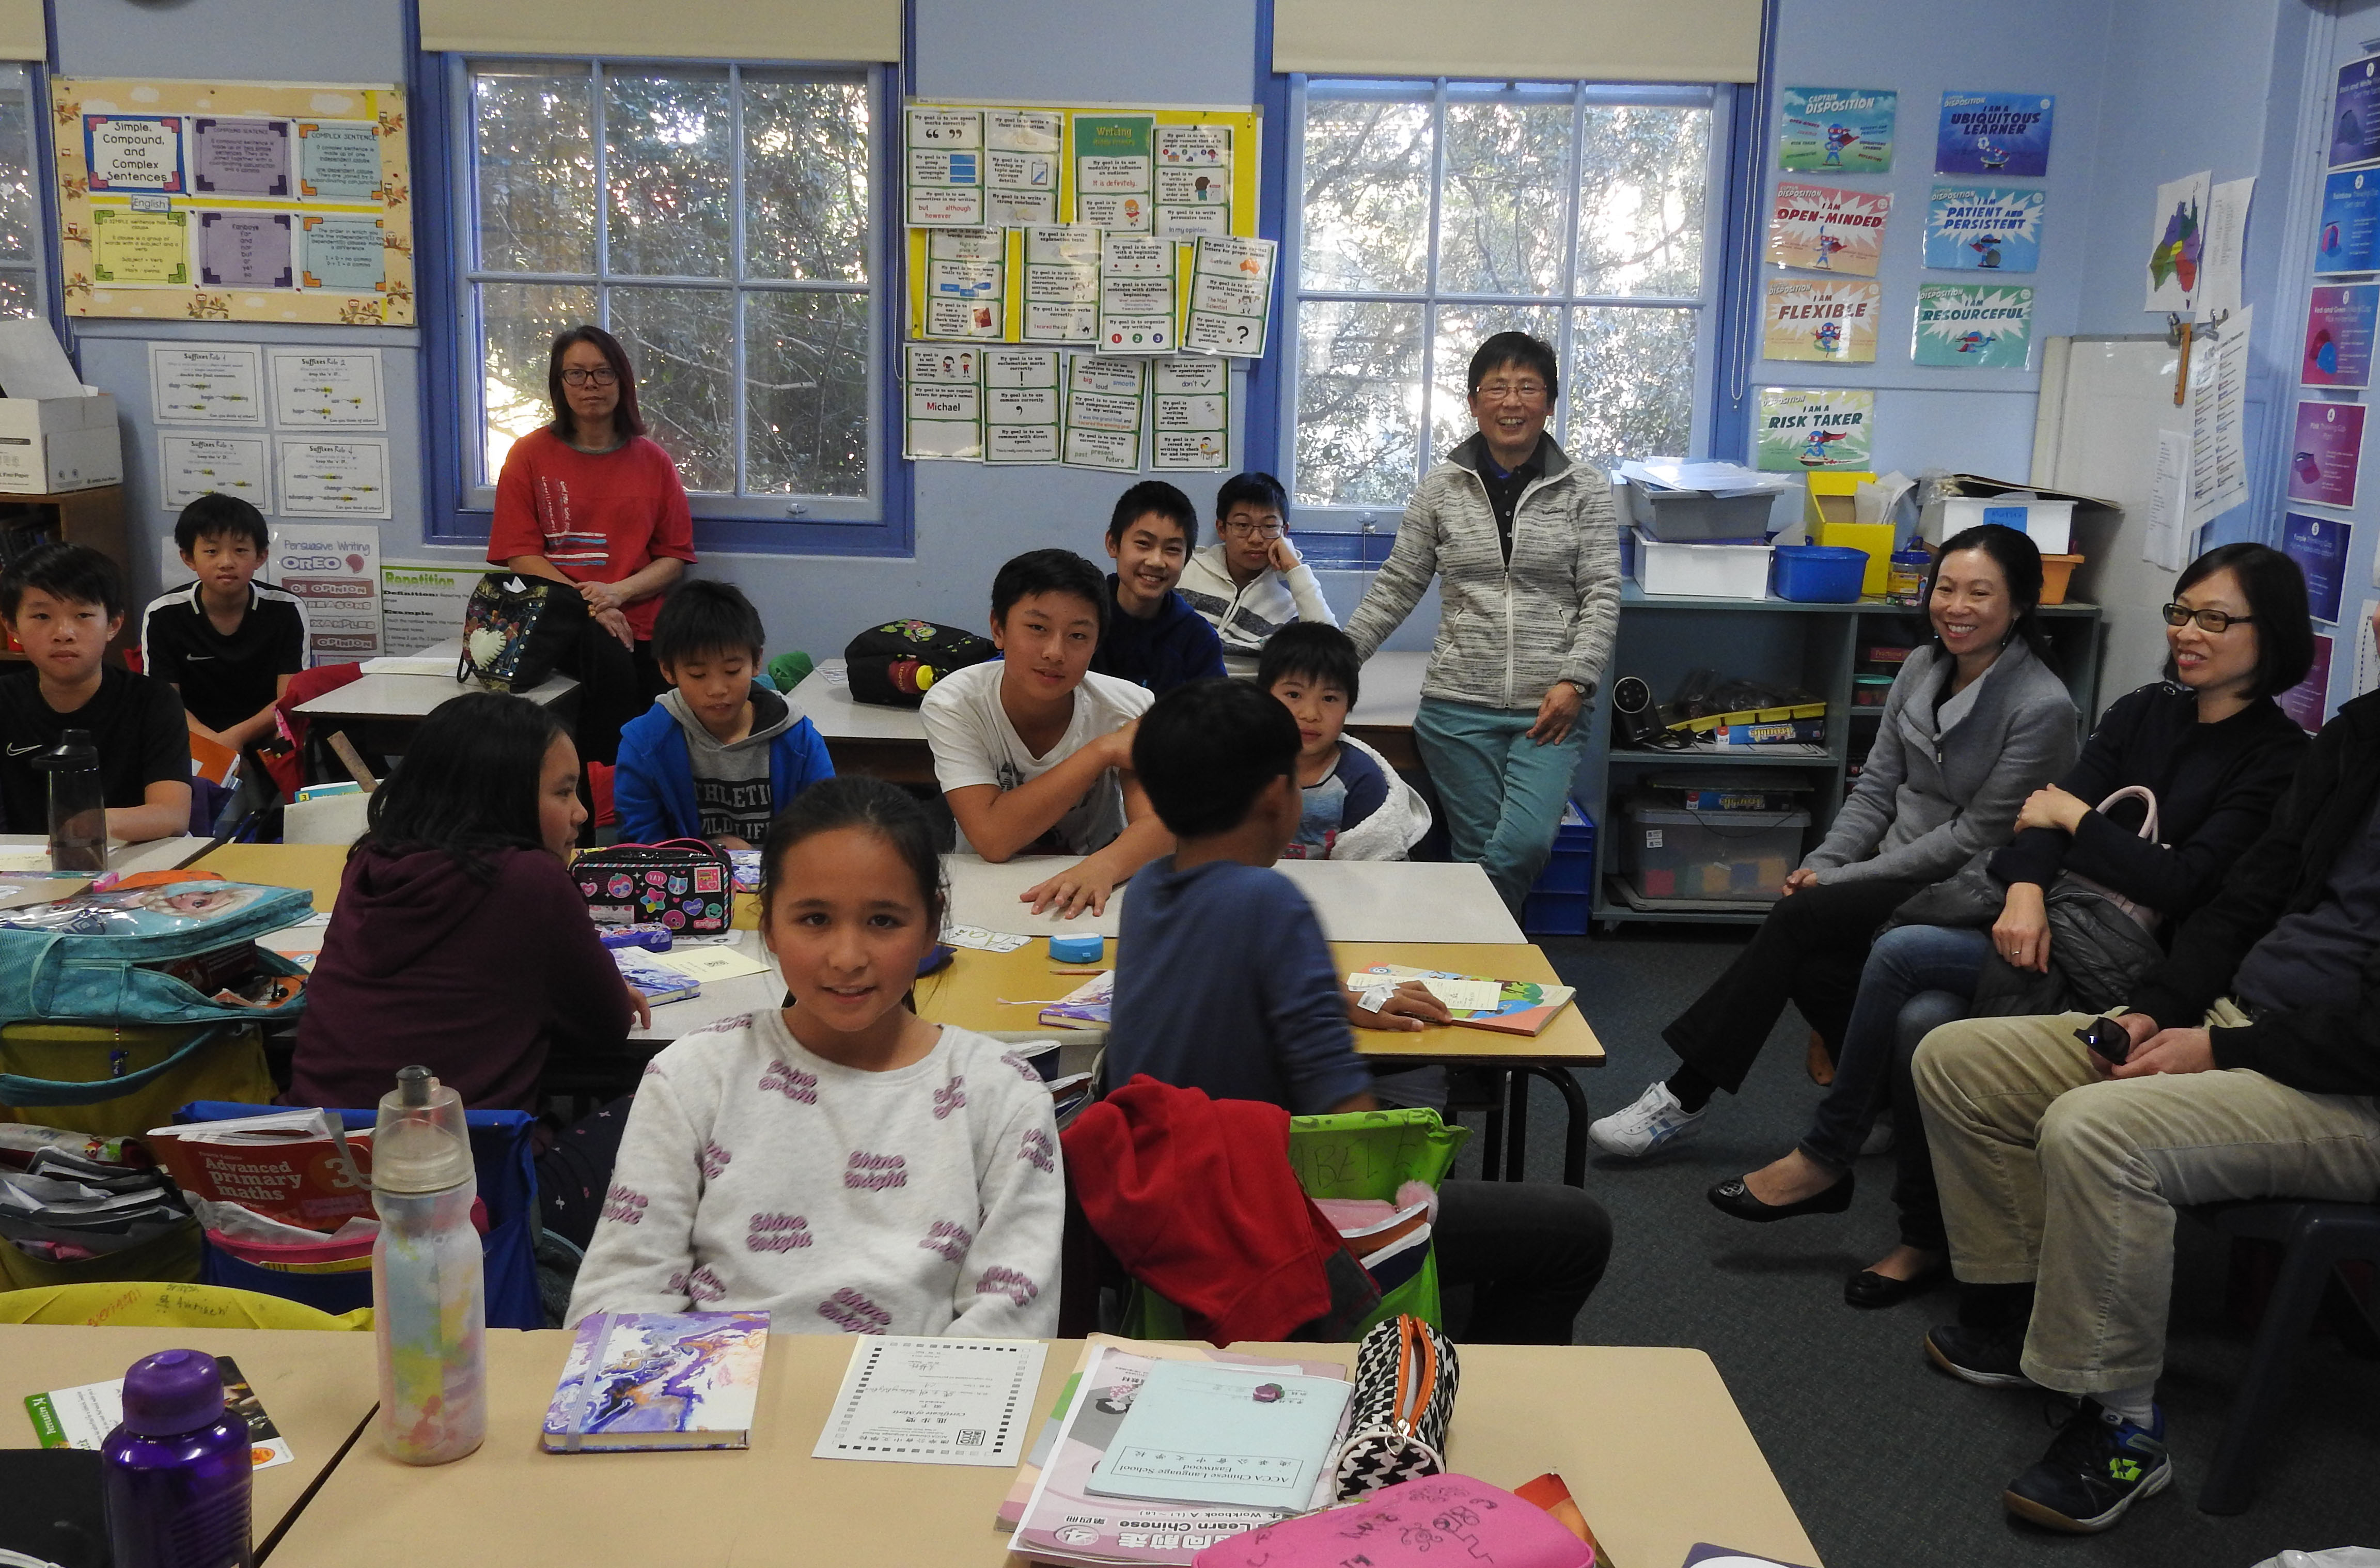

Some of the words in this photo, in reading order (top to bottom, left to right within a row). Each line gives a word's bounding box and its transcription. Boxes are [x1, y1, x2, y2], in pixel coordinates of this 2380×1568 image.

[1809, 93, 1838, 103] CAPTAIN
[1944, 98, 1986, 107] DISPOSITION
[1805, 98, 1875, 115] DISPOSITION
[1951, 112, 2041, 124] UBIQUITOUS
[1097, 128, 1132, 137] Writing
[1963, 124, 2027, 135] LEARNER
[103, 134, 165, 145] Compound,
[124, 148, 145, 156] and
[113, 159, 159, 170] Complex
[107, 171, 167, 182] Sentences
[1932, 191, 1976, 201] DISPOSITION
[134, 198, 166, 209] English
[1947, 207, 2003, 217] PATIENT
[1777, 209, 1882, 228] OPEN-MINDED
[1944, 219, 2026, 230] PERSISTENT
[1768, 284, 1812, 295] DISPOSITION
[1919, 289, 1963, 300] DISPOSITION
[1778, 303, 1868, 320] FLEXIBLE
[1922, 308, 2024, 321] RESOURCEFUL
[302, 358, 325, 366] Suffixes
[1763, 395, 1806, 407] DISPOSITION
[927, 402, 960, 412] Michael
[1768, 415, 1808, 429] RISK
[1813, 412, 1863, 427] TAKER
[309, 446, 333, 454] Suffixes
[2313, 524, 2318, 533] 5
[284, 540, 333, 551] Persuasive
[337, 541, 370, 556] Writing
[281, 556, 342, 571] OREO
[385, 571, 455, 586] Repetition
[311, 584, 367, 594] OPINION
[317, 637, 372, 648] OPINION
[1748, 726, 1796, 742] Trouble
[206, 1157, 293, 1173] Advanced
[324, 1157, 361, 1188] 3
[208, 1170, 302, 1189] primary
[216, 1185, 285, 1201] maths
[1119, 1465, 1155, 1475] School
[1157, 1468, 1207, 1479] Language
[1183, 1464, 1232, 1472] Eastwood
[1210, 1472, 1251, 1481] Chinese
[1255, 1475, 1289, 1483] ACCA
[1119, 1519, 1192, 1532] Chinese
[1197, 1521, 1251, 1532] Learn
[1064, 1529, 1093, 1544] 4
